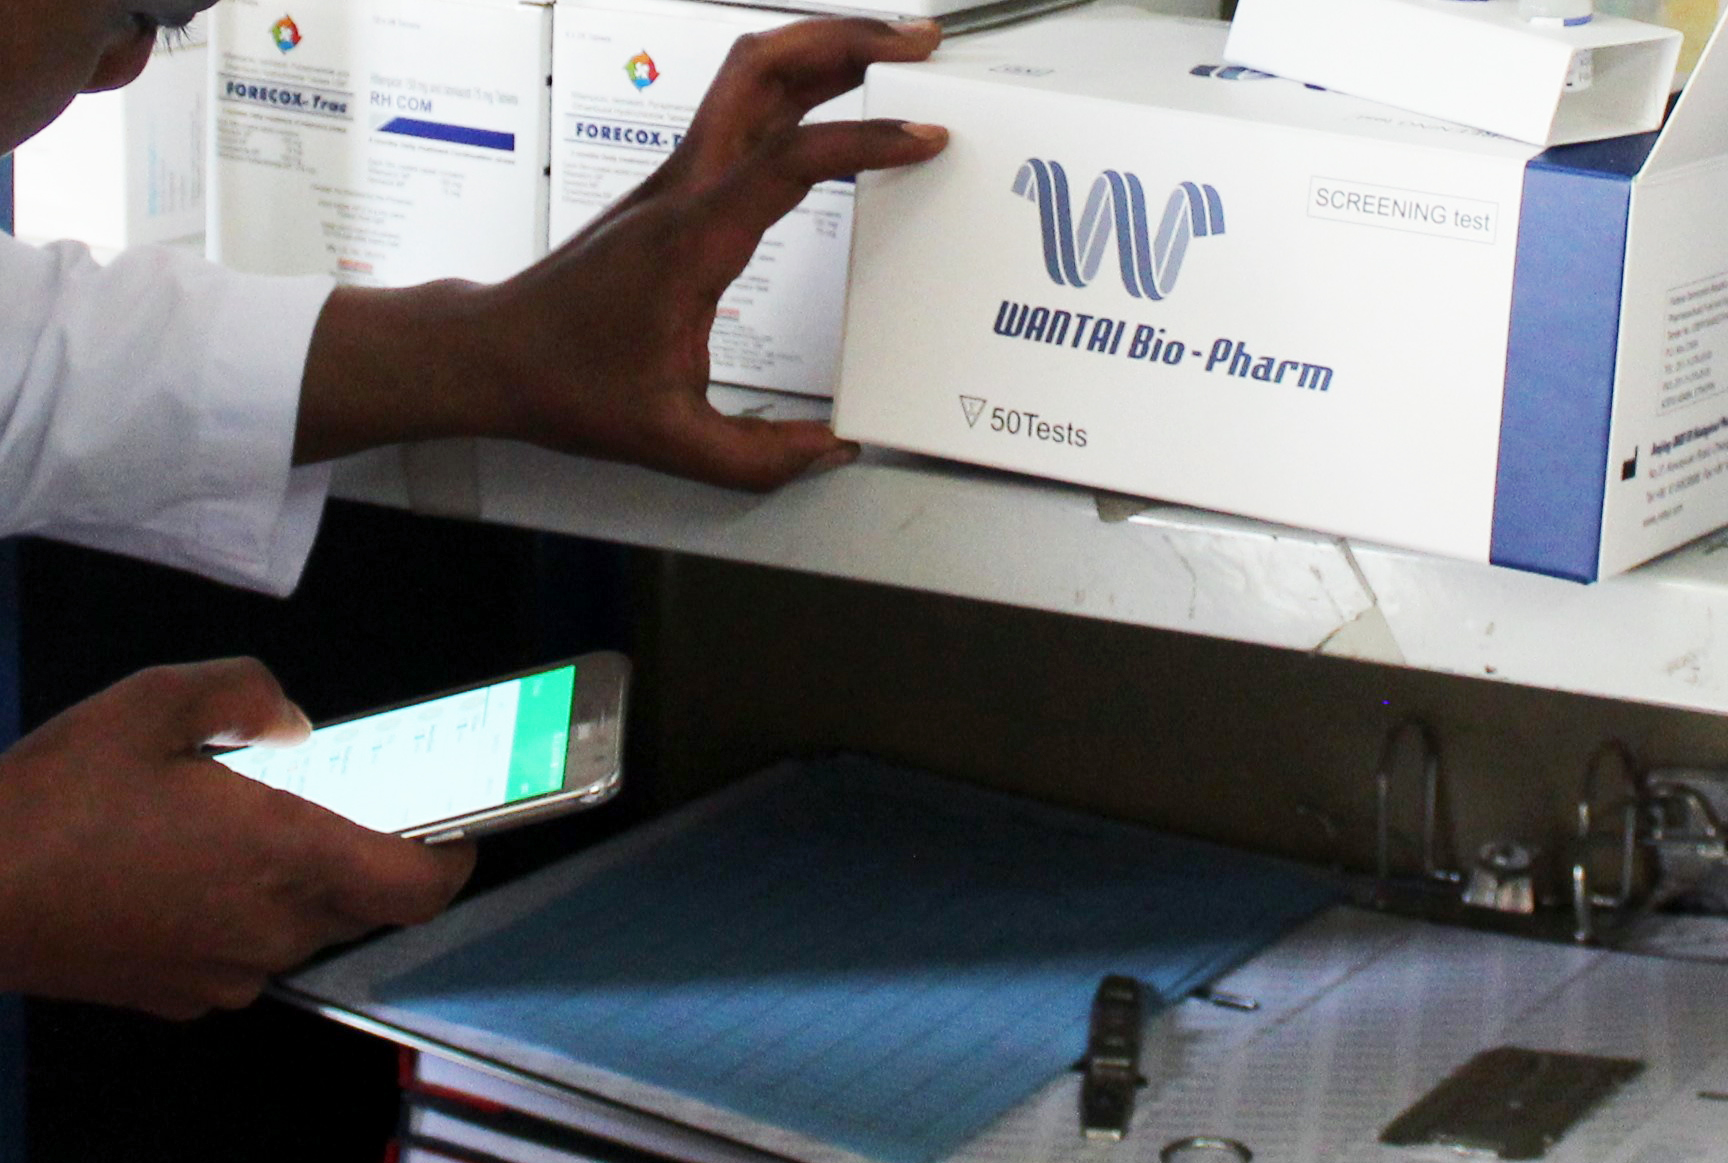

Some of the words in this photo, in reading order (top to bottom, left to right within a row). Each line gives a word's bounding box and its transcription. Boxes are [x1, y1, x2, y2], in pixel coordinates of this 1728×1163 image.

[226, 81, 346, 113] FORECOX-Trac
[370, 91, 391, 106] RH
[397, 96, 432, 112] COM
[1316, 188, 1446, 224] SCREENING
[1454, 210, 1490, 232] test
[993, 300, 1132, 358] WANTAI
[990, 407, 1087, 447] 50Tests
